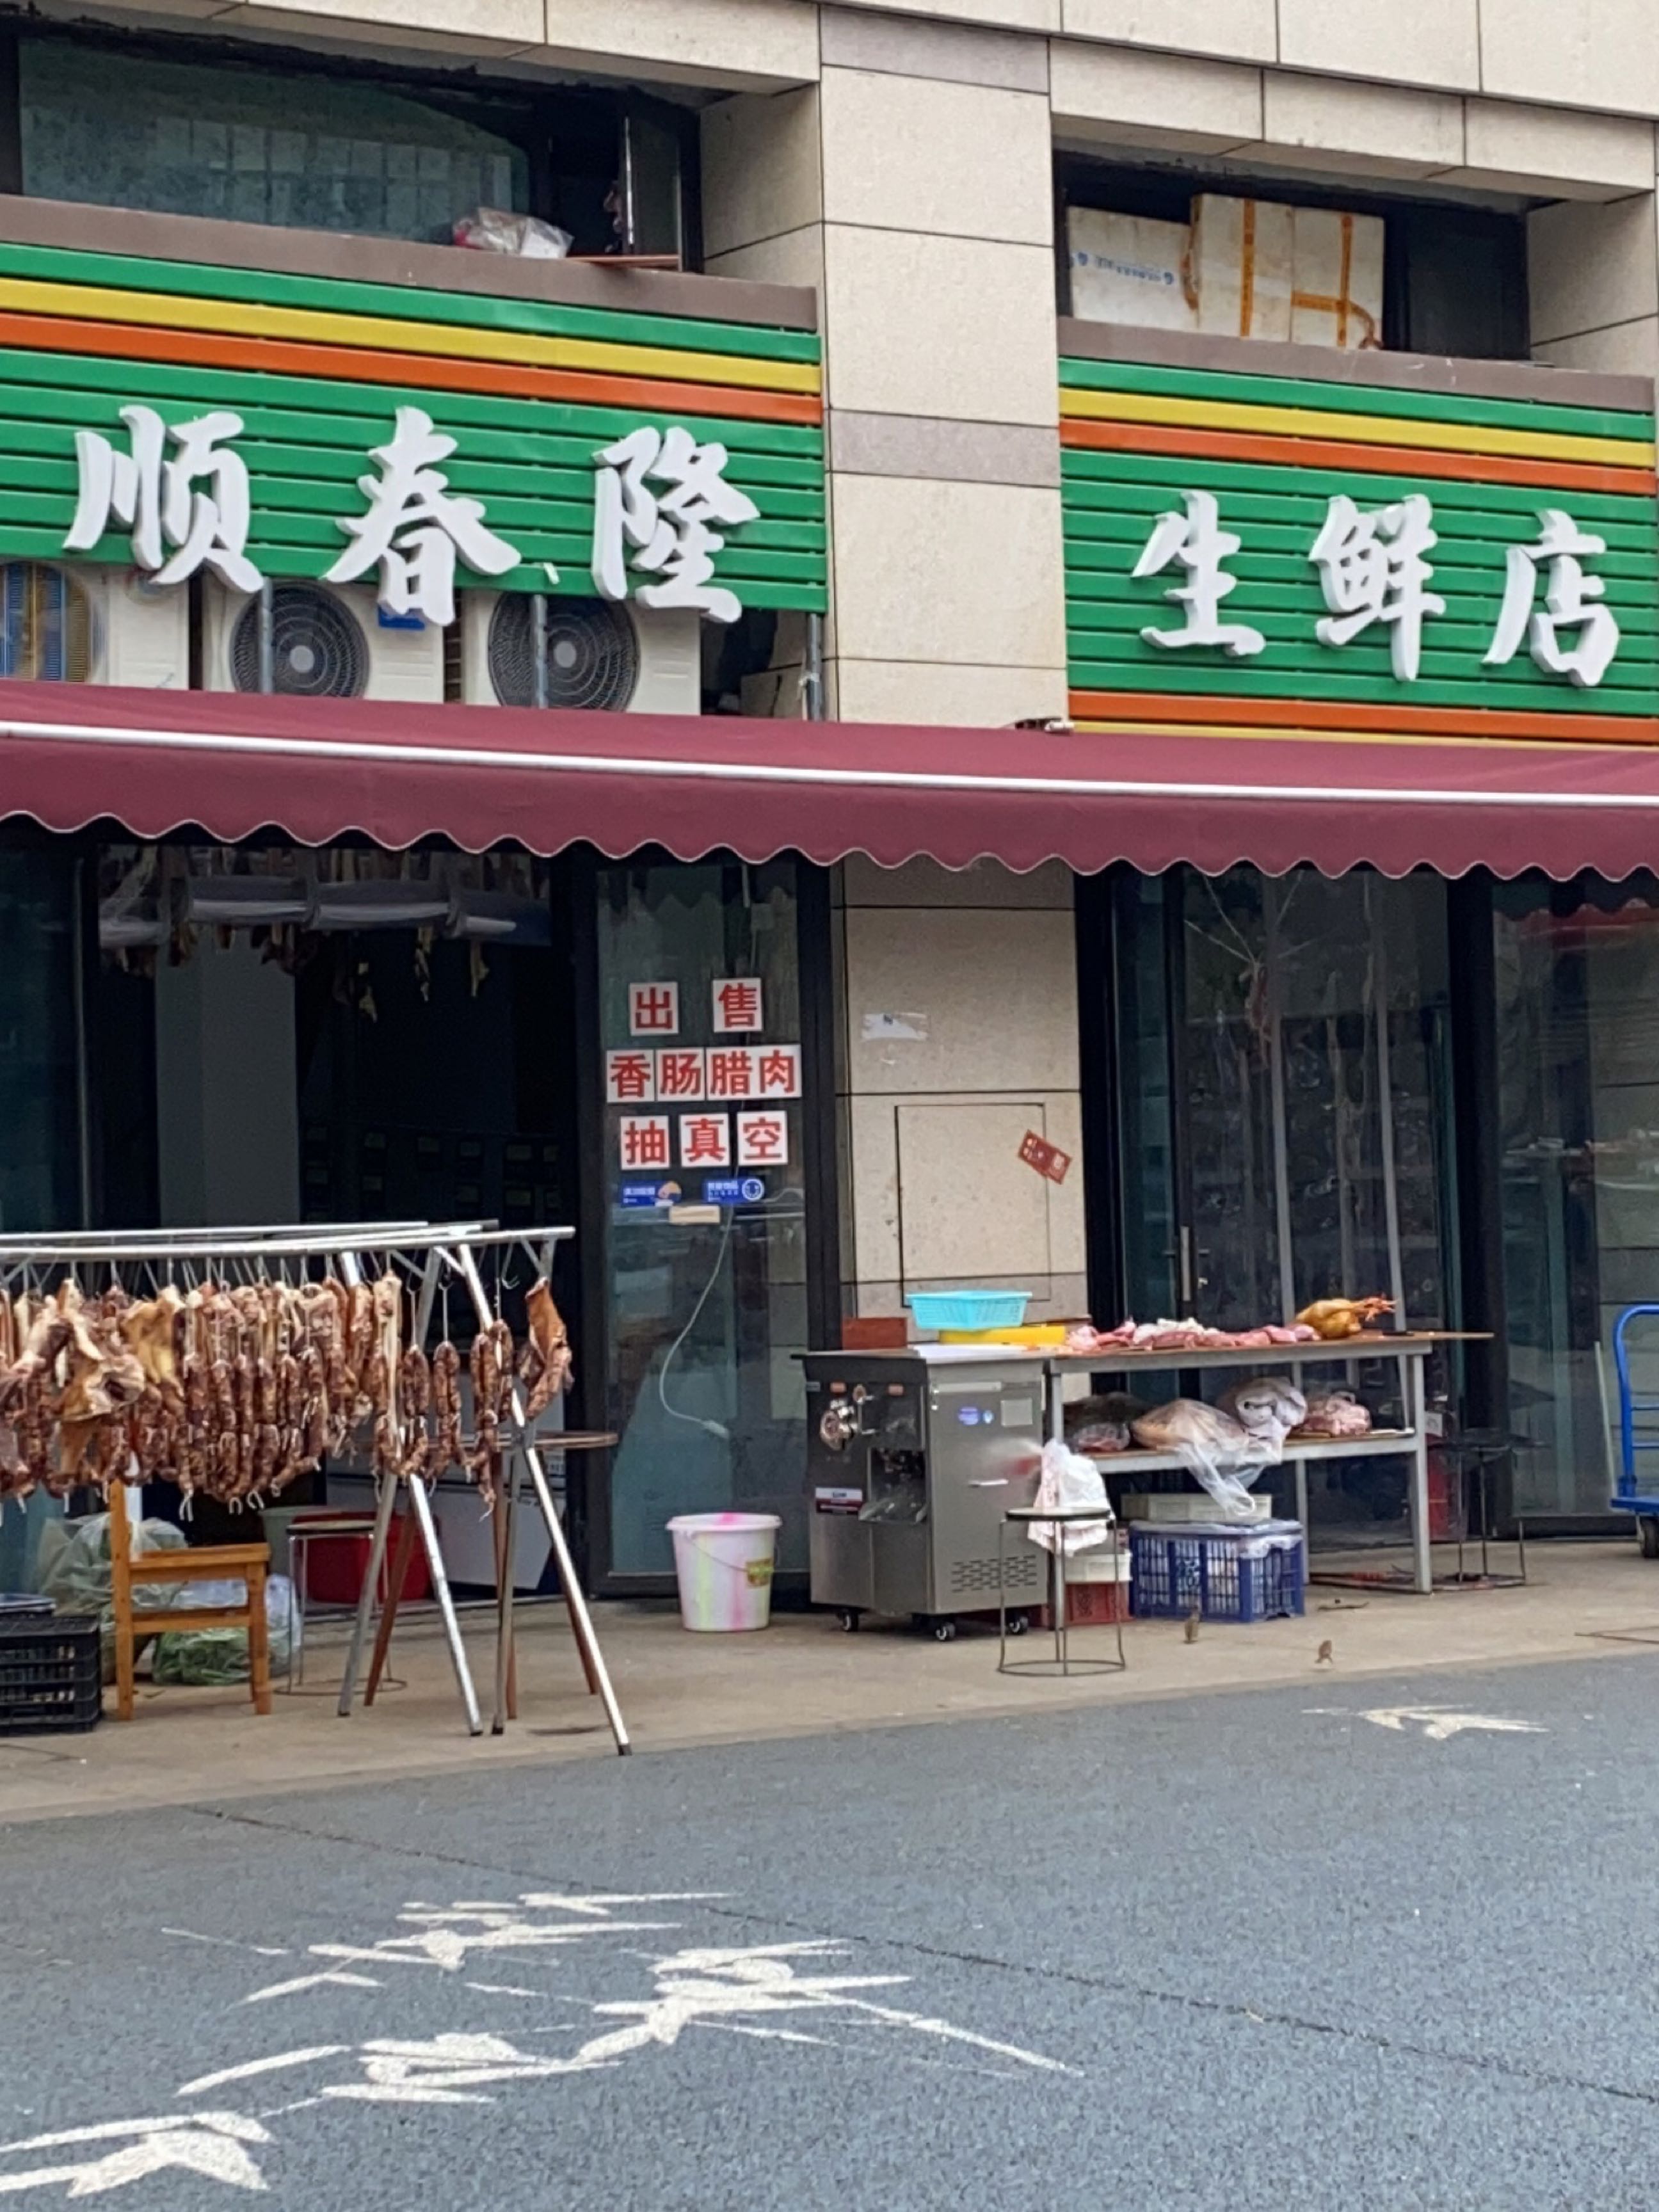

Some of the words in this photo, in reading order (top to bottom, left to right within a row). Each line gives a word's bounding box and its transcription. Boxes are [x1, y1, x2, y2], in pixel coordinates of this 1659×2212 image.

[63, 405, 761, 626] 顺春隆
[1130, 490, 1620, 687] 生鲜店
[635, 982, 758, 1030] 出售
[610, 1049, 795, 1098] 香肠腊肉
[624, 1117, 783, 1165] 抽真空
